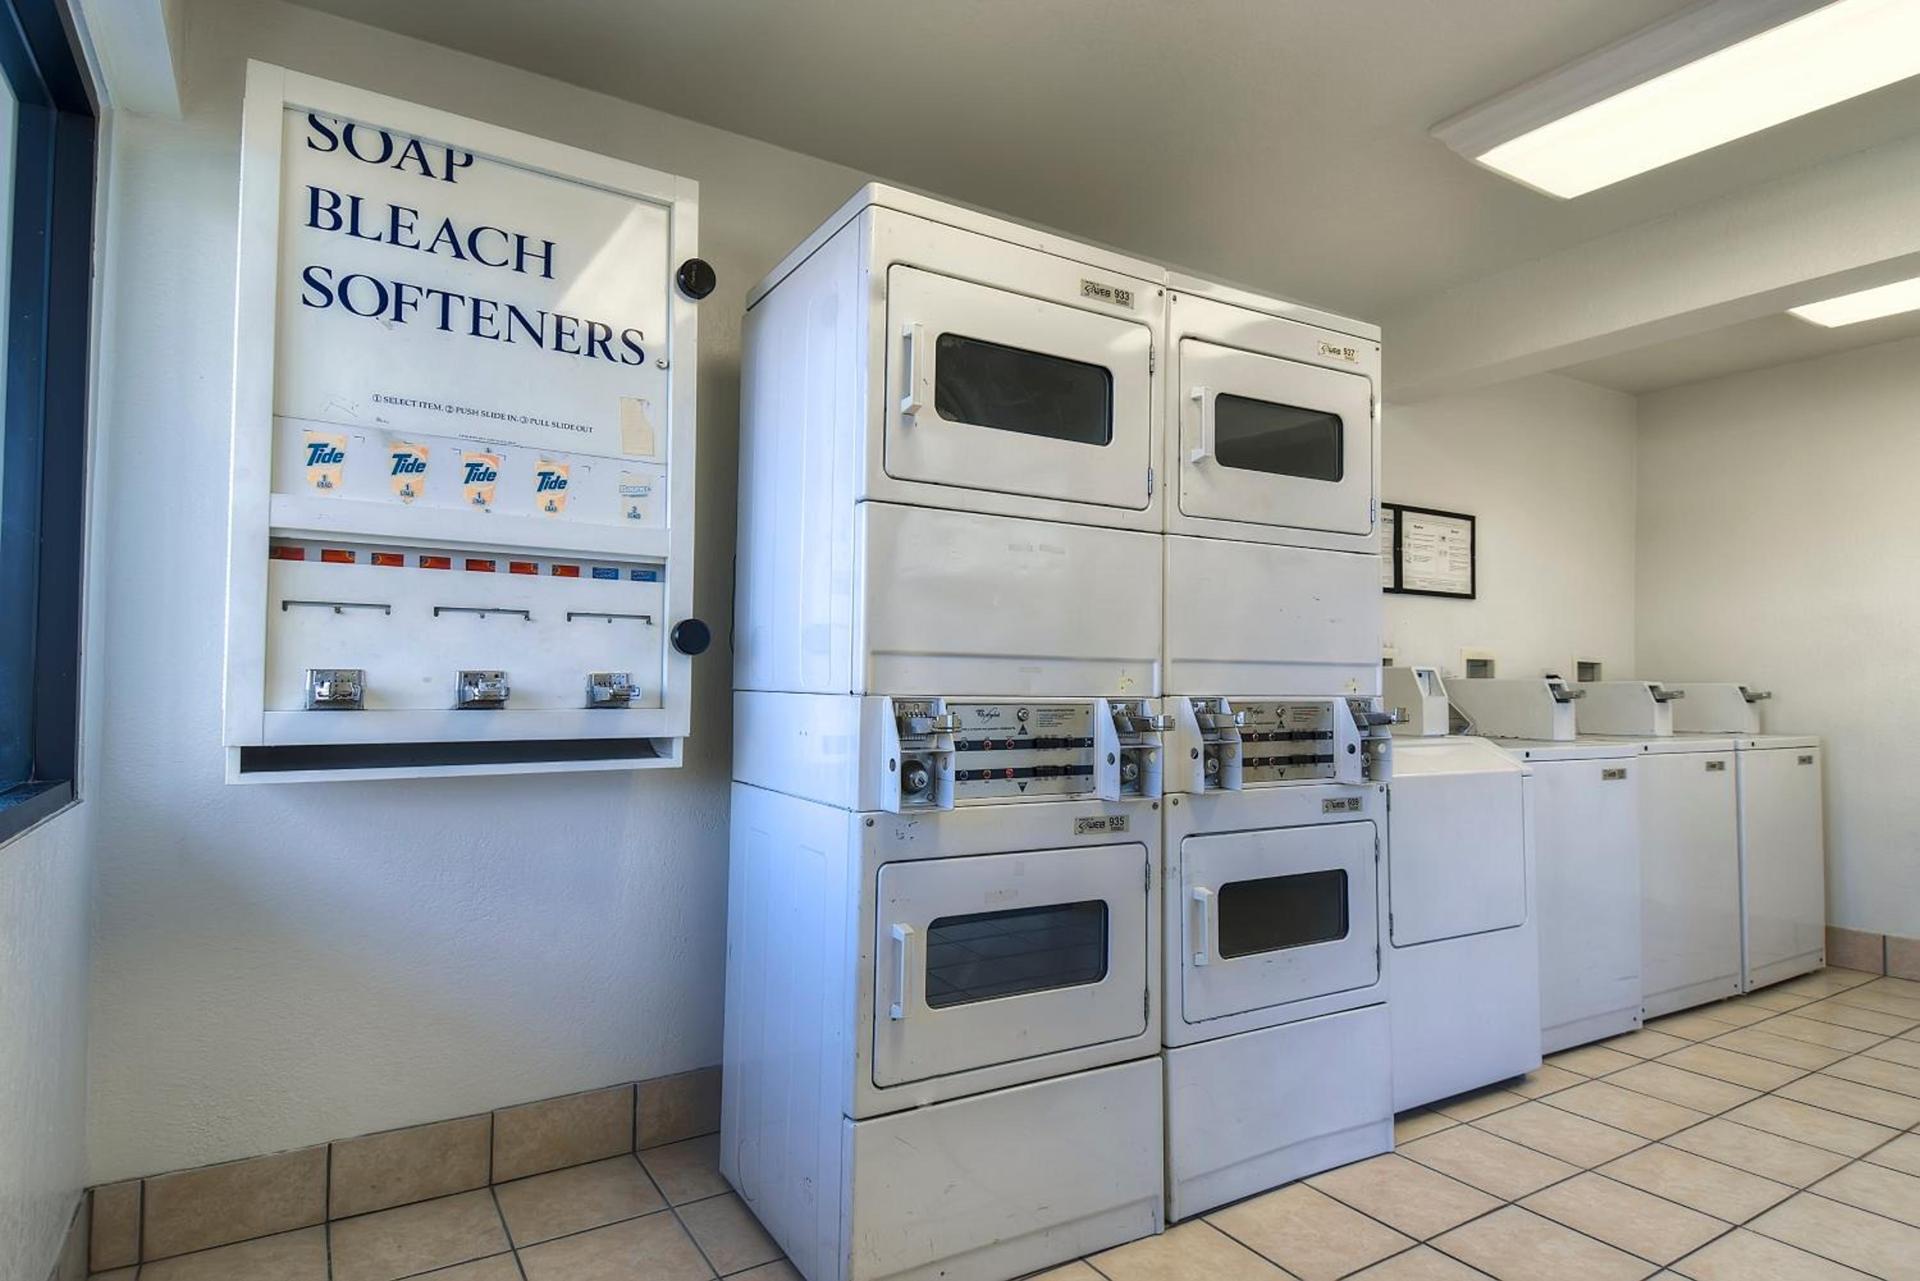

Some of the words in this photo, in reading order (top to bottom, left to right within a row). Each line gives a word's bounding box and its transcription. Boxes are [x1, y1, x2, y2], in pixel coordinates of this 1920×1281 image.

[306, 113, 475, 184] SOAP
[304, 185, 557, 280] BLEACH
[1114, 288, 1130, 301] 933
[301, 265, 646, 367] SOFTENERS
[383, 395, 417, 408] SELECT
[419, 400, 444, 412] ITEM.
[455, 406, 480, 416] PUSH
[480, 410, 506, 420] SLIDE
[529, 417, 550, 428] PULL
[551, 420, 575, 431] SLIDE
[575, 425, 594, 434] OUT
[306, 442, 345, 467] Tide
[391, 453, 427, 476] Tide
[463, 462, 497, 484] Tide
[536, 471, 568, 493] Tide
[1109, 816, 1125, 826] 935
